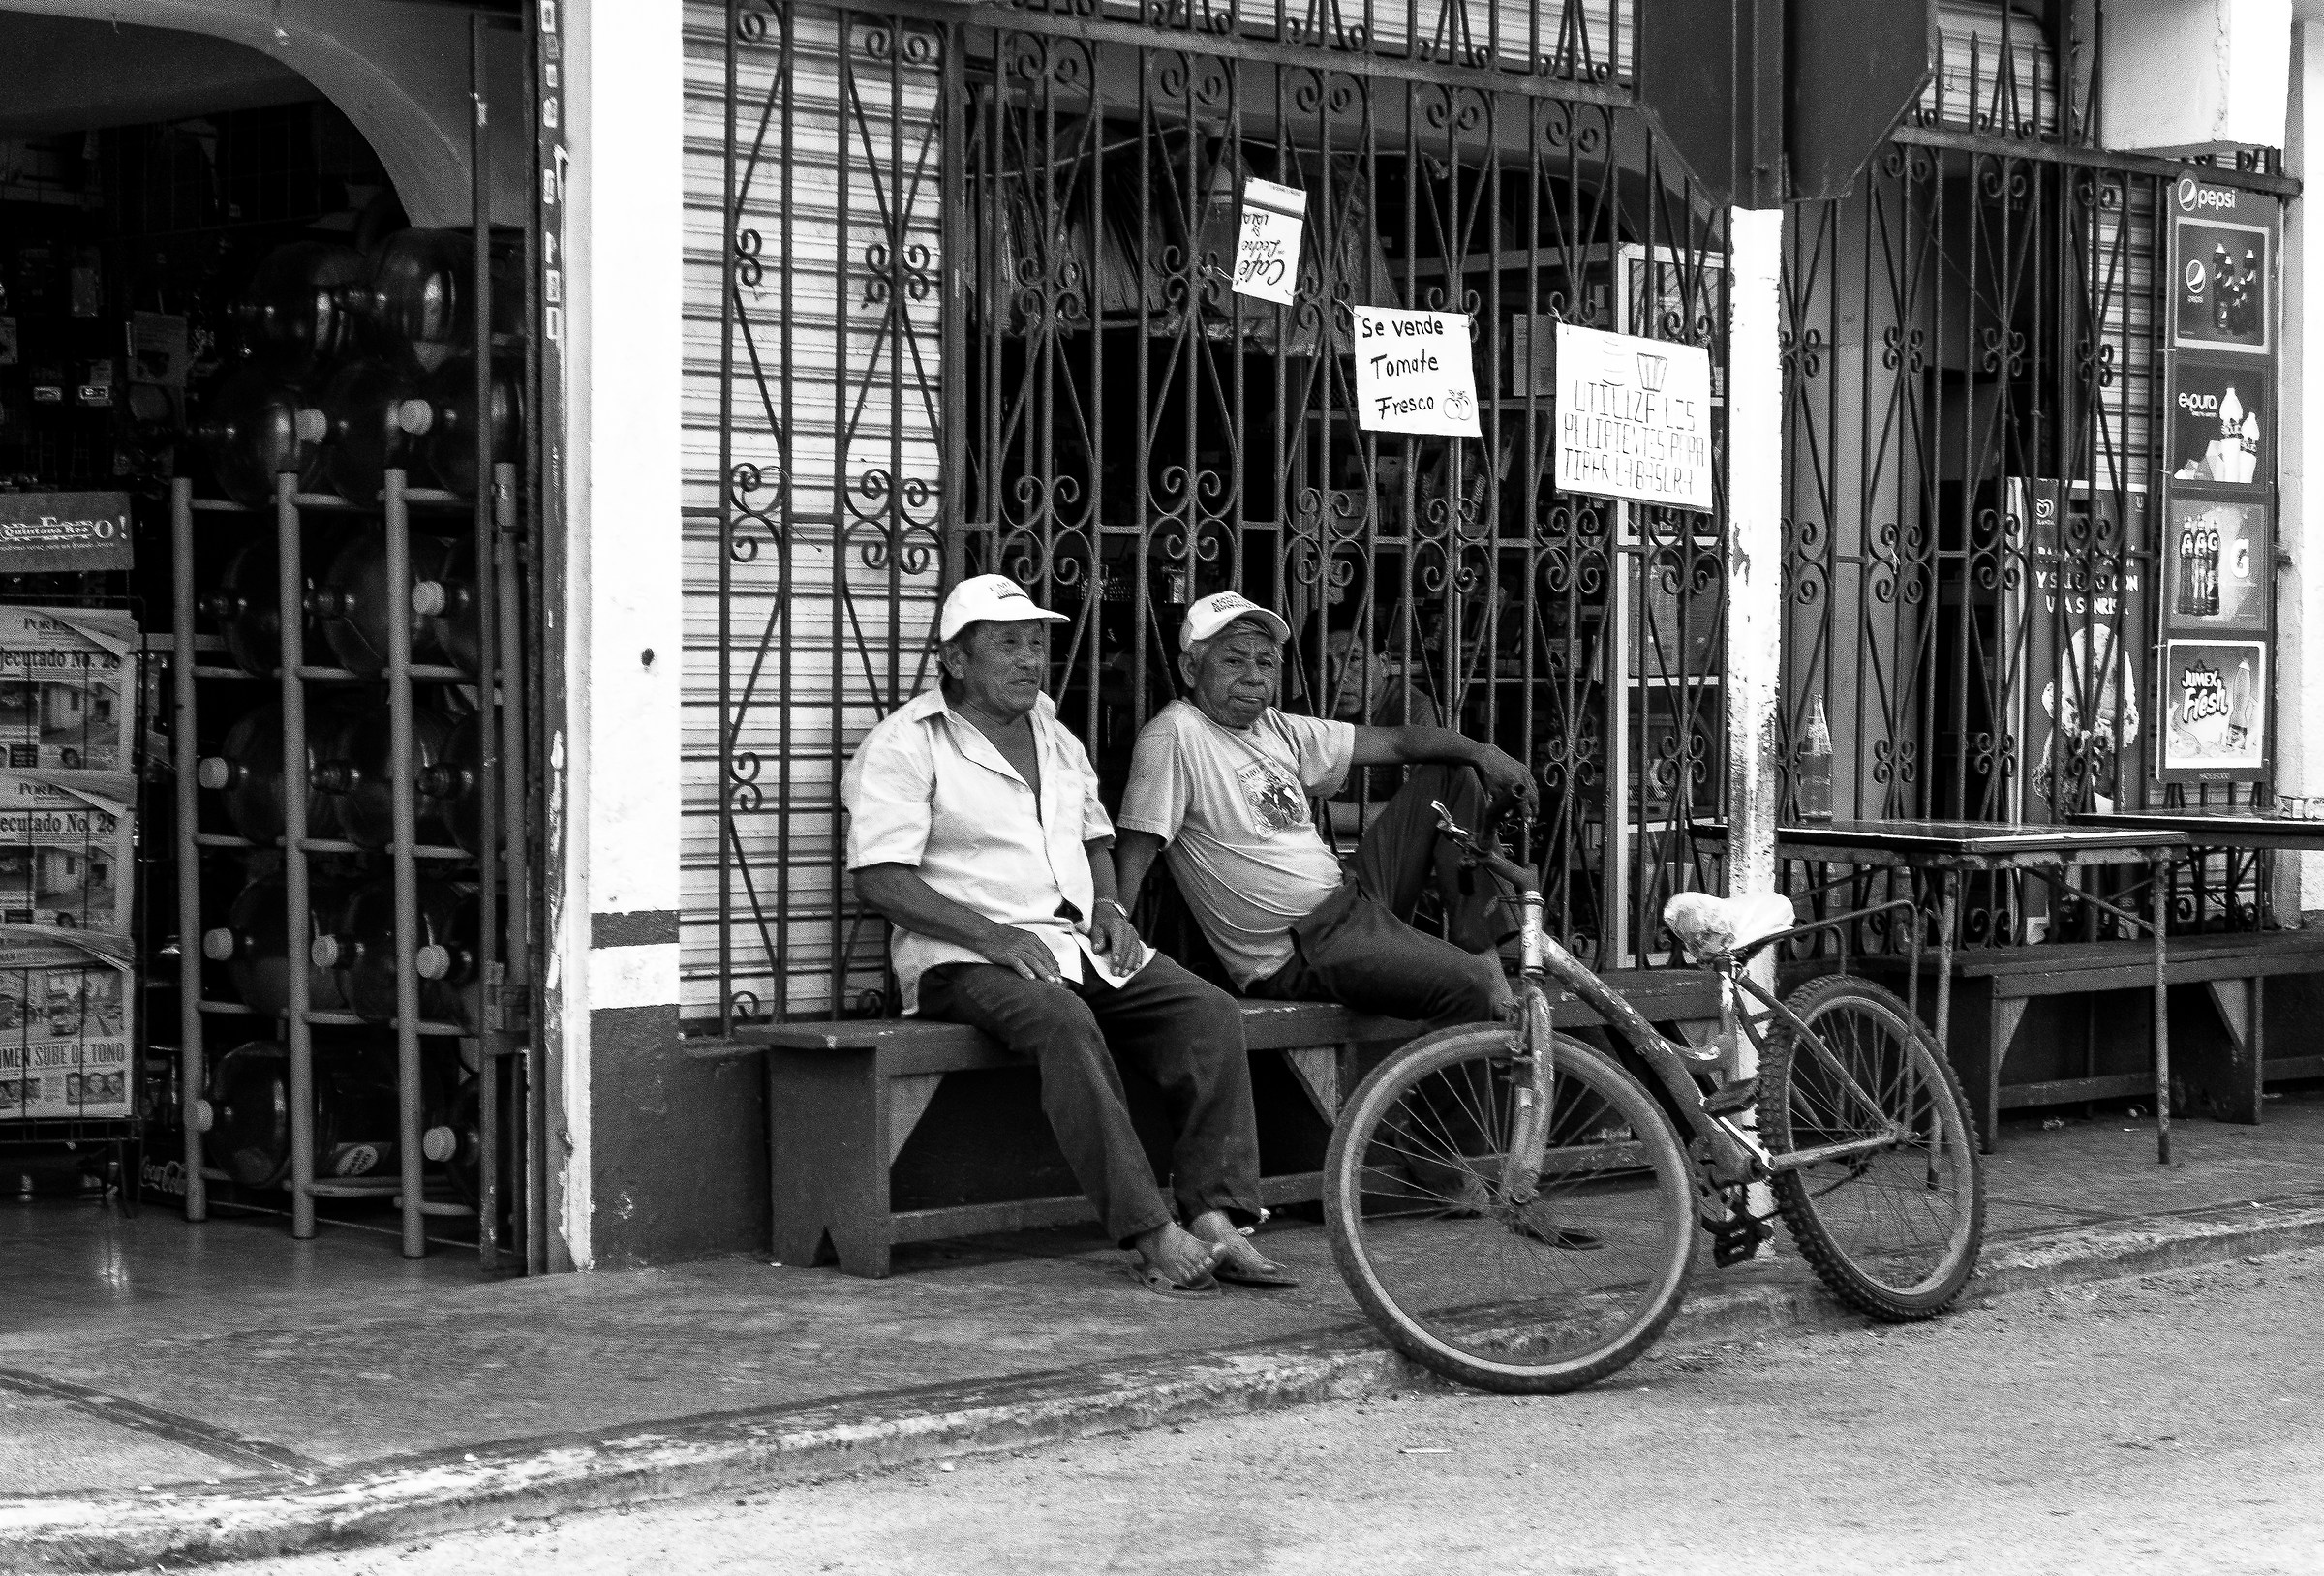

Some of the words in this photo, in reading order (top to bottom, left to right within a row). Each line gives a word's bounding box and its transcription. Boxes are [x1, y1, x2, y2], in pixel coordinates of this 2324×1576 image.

[2198, 190, 2236, 210] pepsi
[1241, 239, 1281, 258] Leche
[1362, 318, 1385, 338] Se
[1370, 349, 1439, 379] Tomate
[1375, 395, 1434, 419] Fresco
[2230, 538, 2249, 579] G
[2182, 670, 2217, 687] JUMEX
[2182, 679, 2228, 724] Fresh
[35, 1045, 68, 1066] SUBE
[71, 1044, 87, 1064] DE
[91, 1042, 125, 1063] TONO
